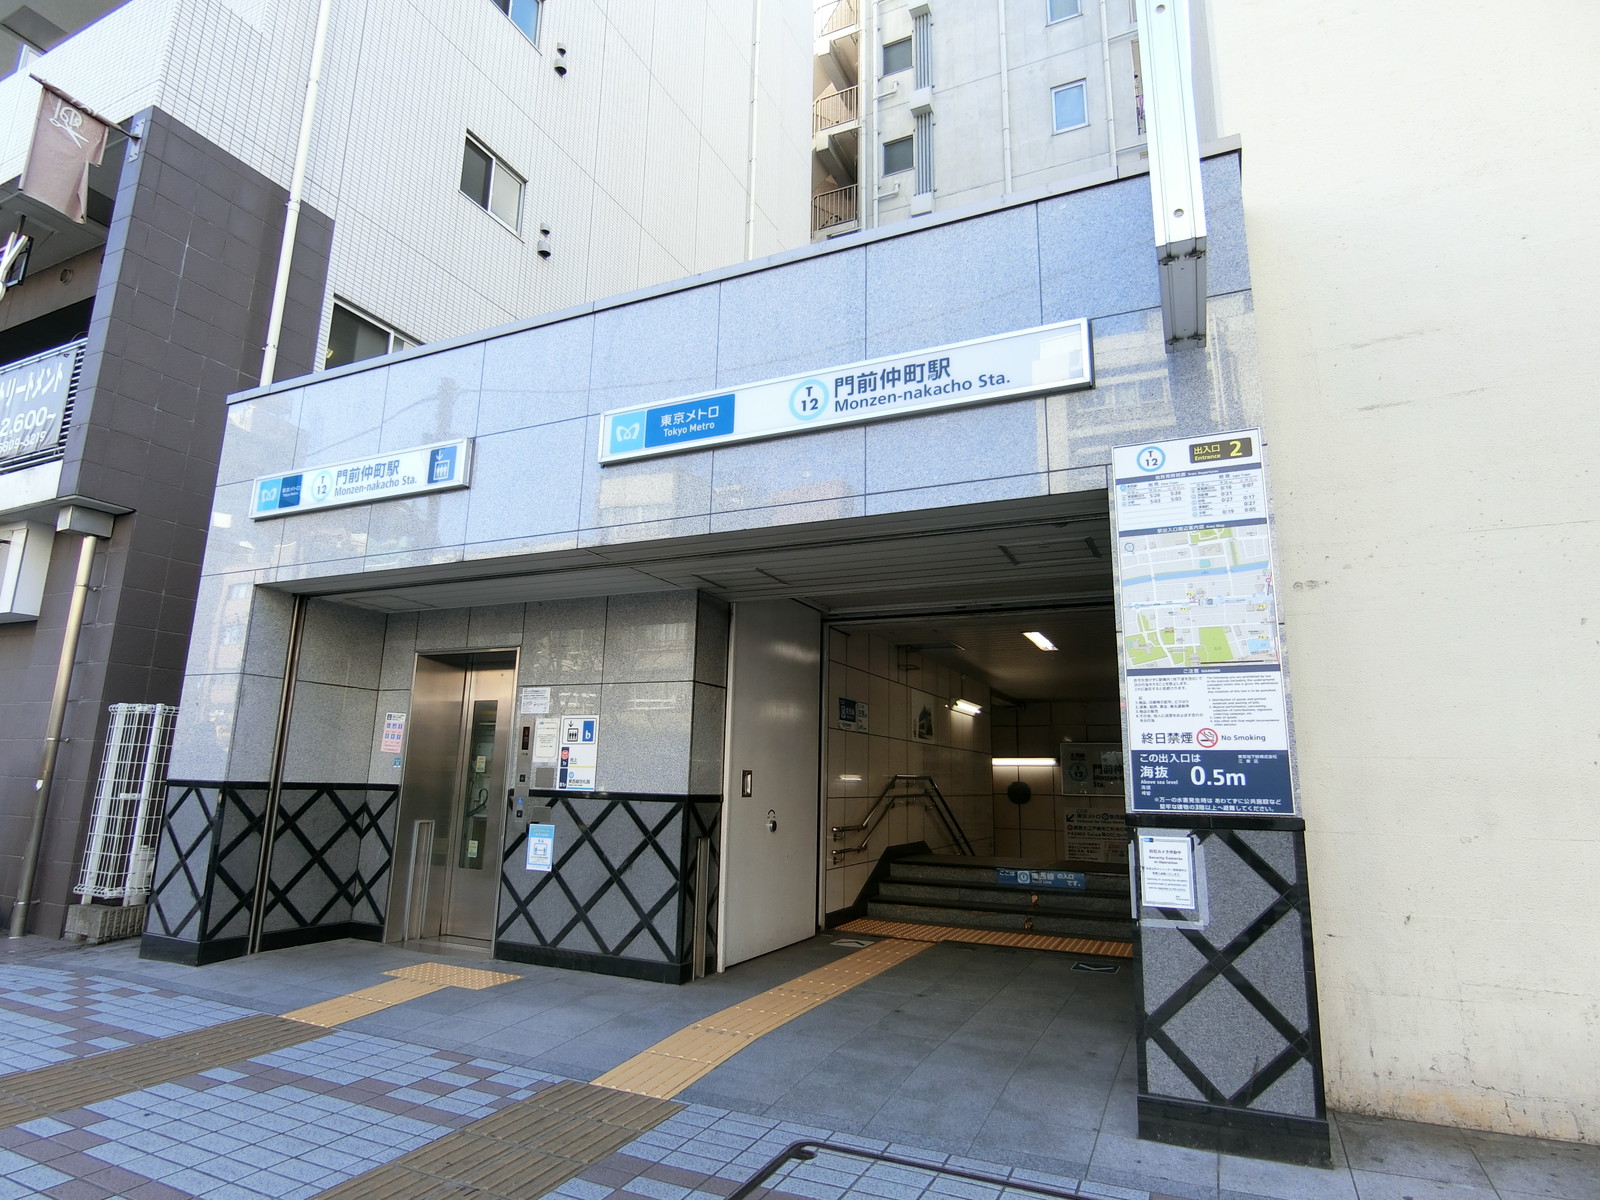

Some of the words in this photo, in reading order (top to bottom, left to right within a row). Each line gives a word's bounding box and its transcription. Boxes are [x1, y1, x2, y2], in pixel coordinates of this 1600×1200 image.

[834, 357, 951, 398] 門前仲町駅
[806, 386, 813, 397] T
[834, 379, 972, 412] Monzen-nakacho
[979, 374, 1010, 388] Sta.
[801, 398, 818, 412] 12
[660, 405, 720, 427] 東京メトロ
[663, 427, 688, 437] Tokyo
[689, 422, 715, 432] Metro
[1148, 450, 1153, 458] T
[1193, 444, 1220, 455] 出入口
[1229, 440, 1243, 457] 2
[1145, 458, 1158, 466] 12
[1194, 453, 1221, 461] Entrance
[321, 475, 326, 484] T
[336, 460, 399, 486] 門前仲町駅
[317, 484, 327, 494] 12
[334, 478, 399, 496] Monzen-nakacho
[402, 475, 417, 486] Sta.
[585, 730, 591, 740] b
[1141, 732, 1194, 744] 終日禁煙
[1234, 734, 1266, 742] Smoking
[1140, 753, 1201, 763] この出入口は
[1140, 765, 1169, 779] 海抜
[1190, 765, 1246, 786] 0.5m
